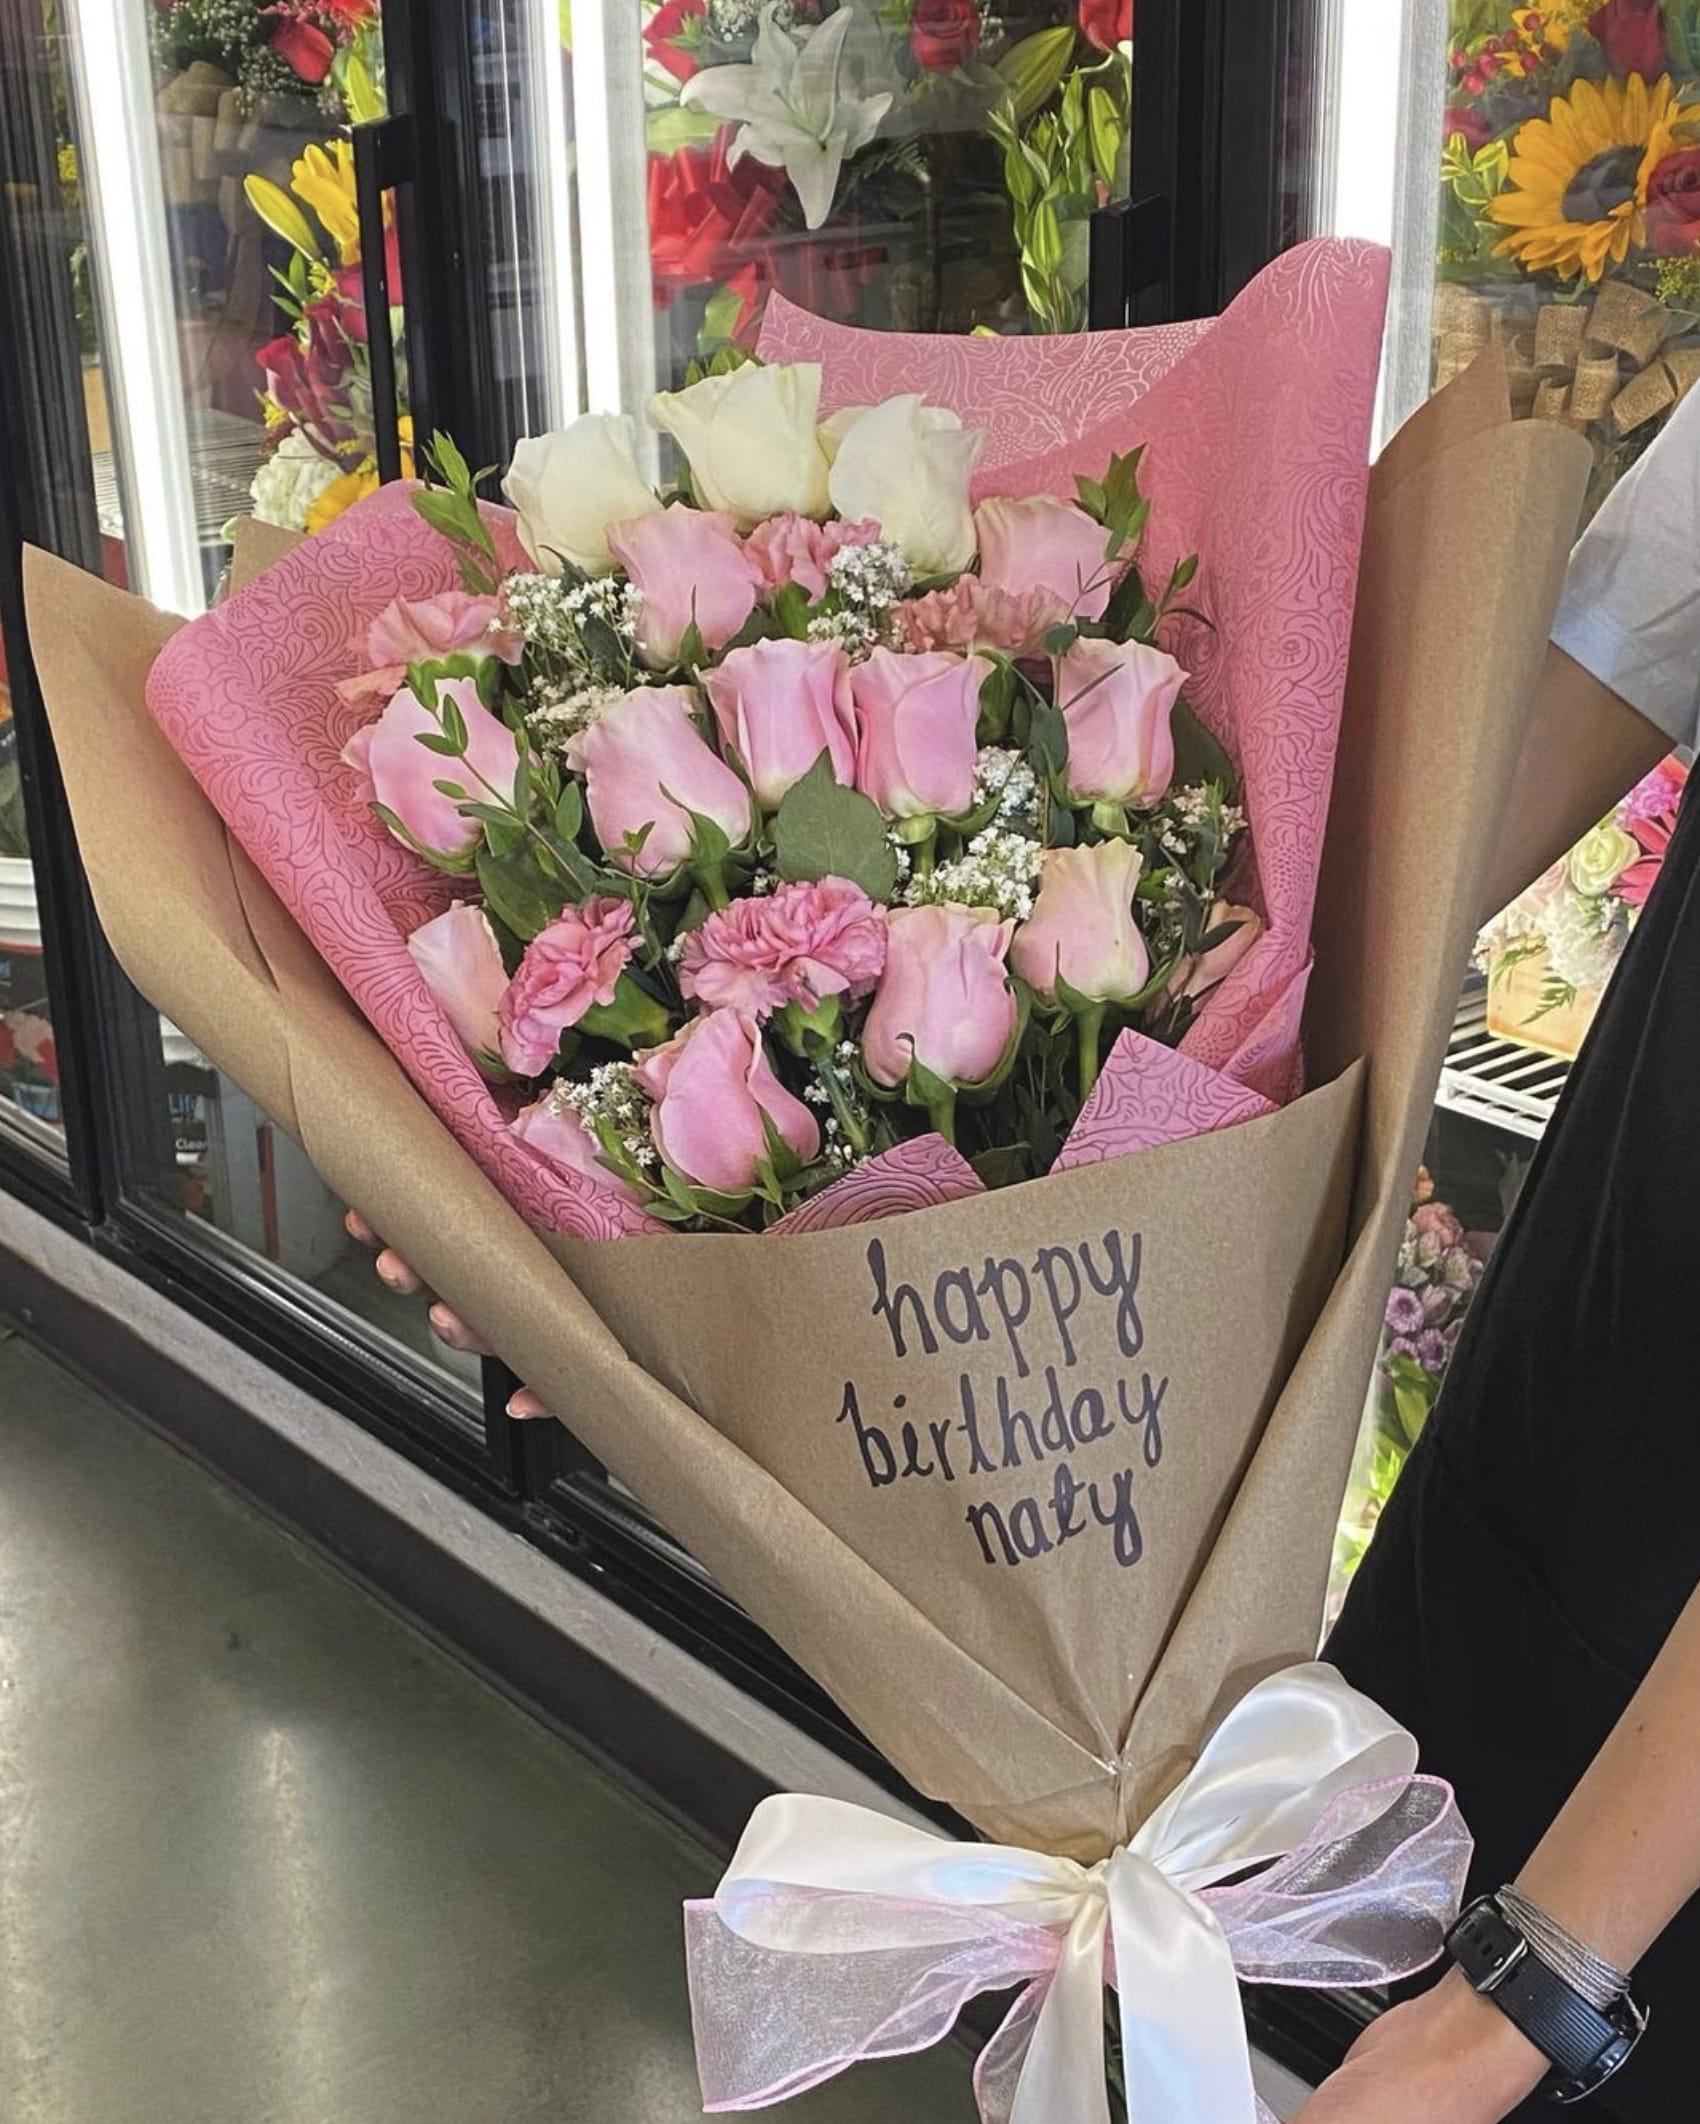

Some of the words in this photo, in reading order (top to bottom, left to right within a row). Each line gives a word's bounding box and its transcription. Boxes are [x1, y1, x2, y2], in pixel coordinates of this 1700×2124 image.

[867, 1229, 1143, 1378] happy
[836, 1366, 1169, 1487] birthday
[966, 1462, 1143, 1567] naty
